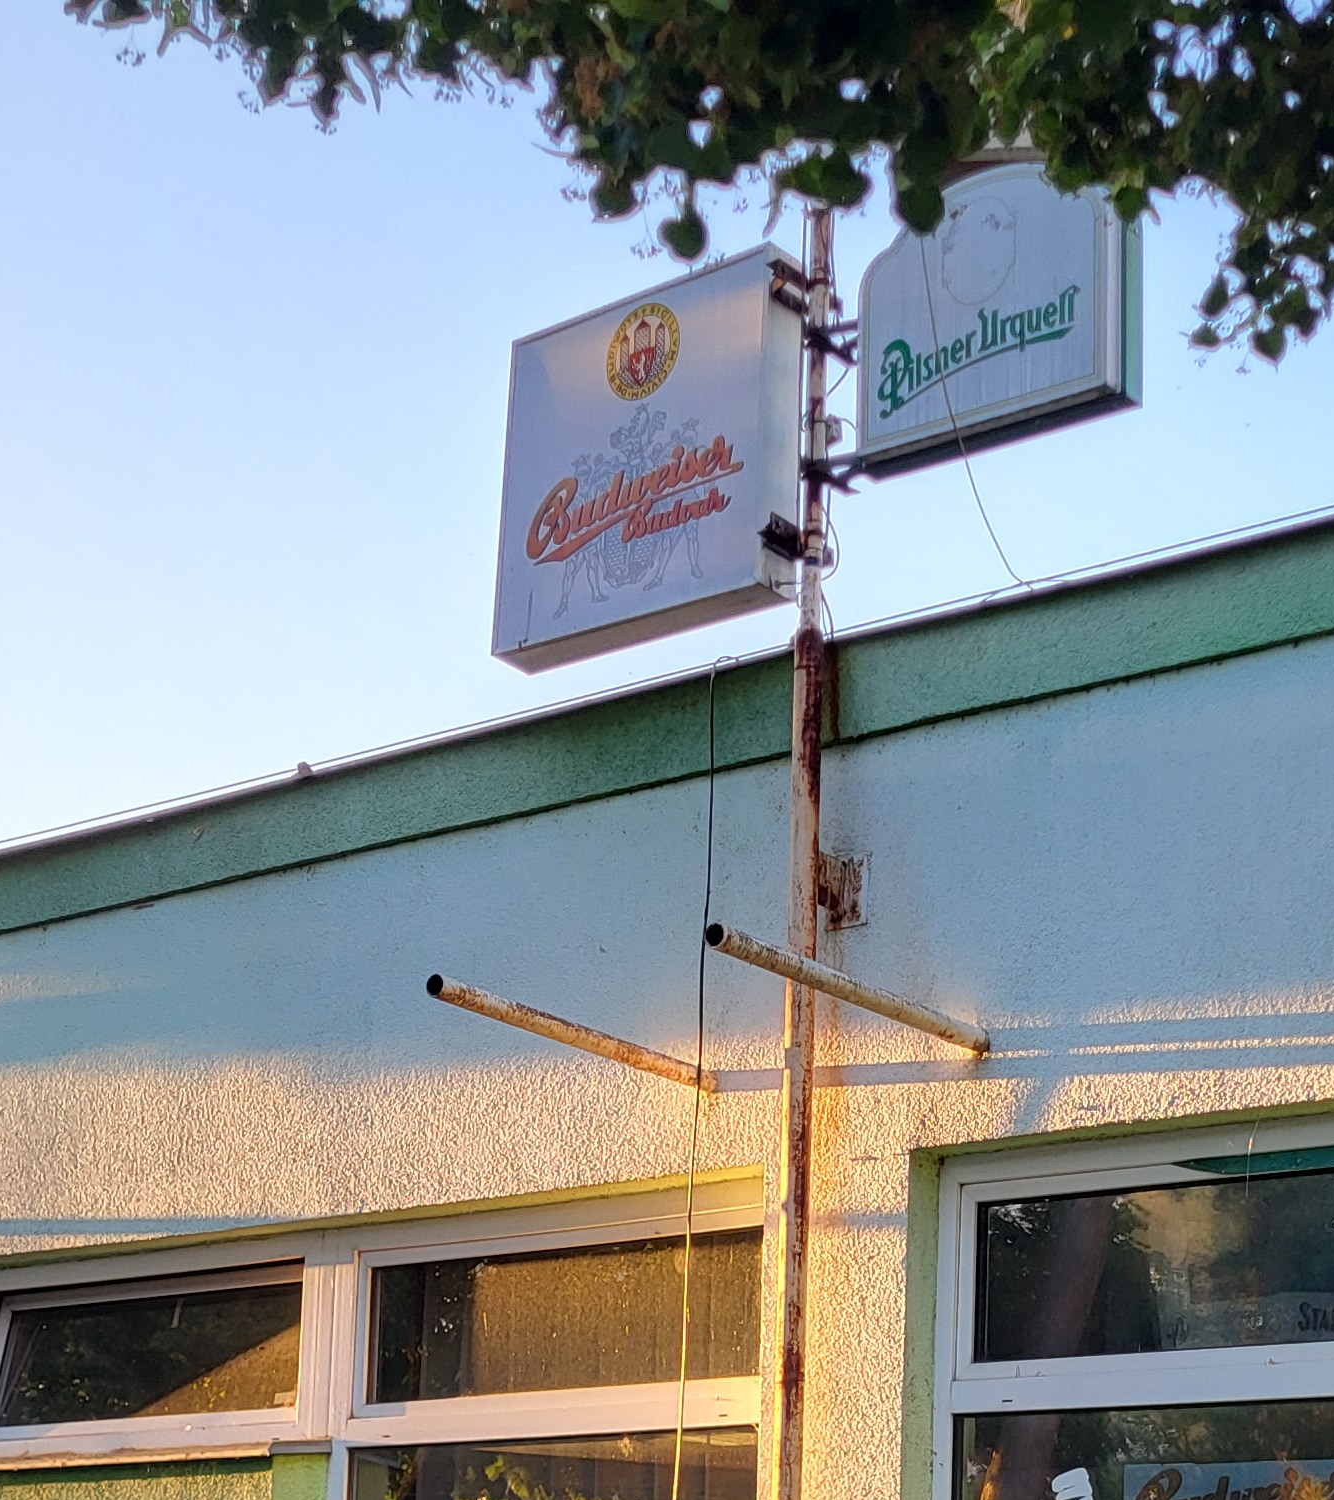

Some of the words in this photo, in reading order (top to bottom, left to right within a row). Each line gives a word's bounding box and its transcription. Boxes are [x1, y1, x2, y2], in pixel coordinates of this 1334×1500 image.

[878, 338, 977, 419] Pilsner
[977, 284, 1081, 352] Urquell
[526, 434, 744, 560] Budweiser
[621, 486, 731, 543] Budvar
